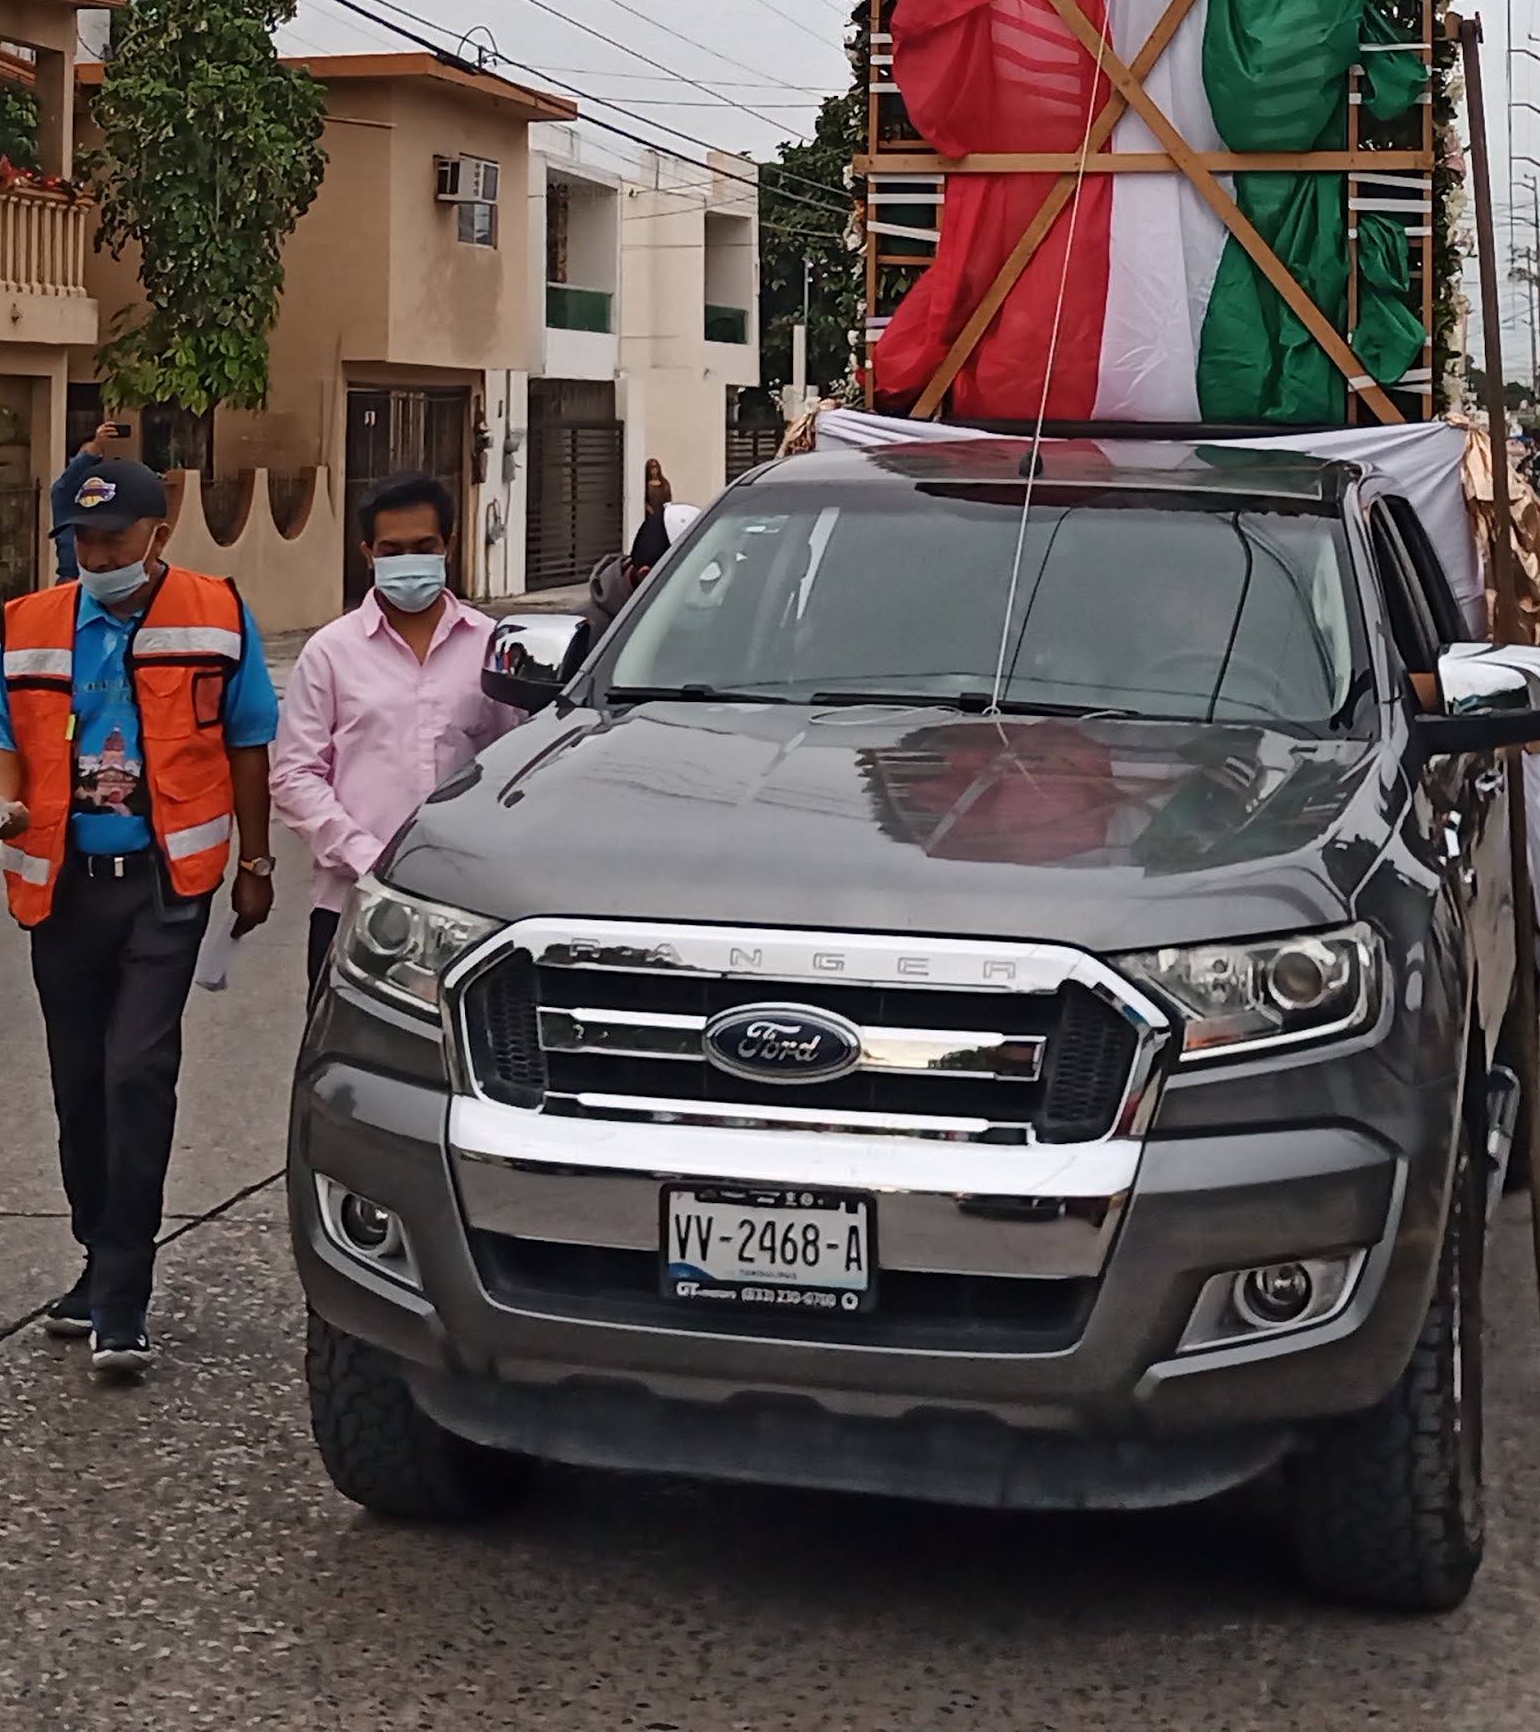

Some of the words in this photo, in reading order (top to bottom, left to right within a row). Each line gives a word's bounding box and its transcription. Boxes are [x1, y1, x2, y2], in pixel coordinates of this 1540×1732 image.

[569, 938, 1017, 980] RANGER
[737, 1021, 819, 1061] Ford
[675, 1214, 863, 1272] VV-2468-A
